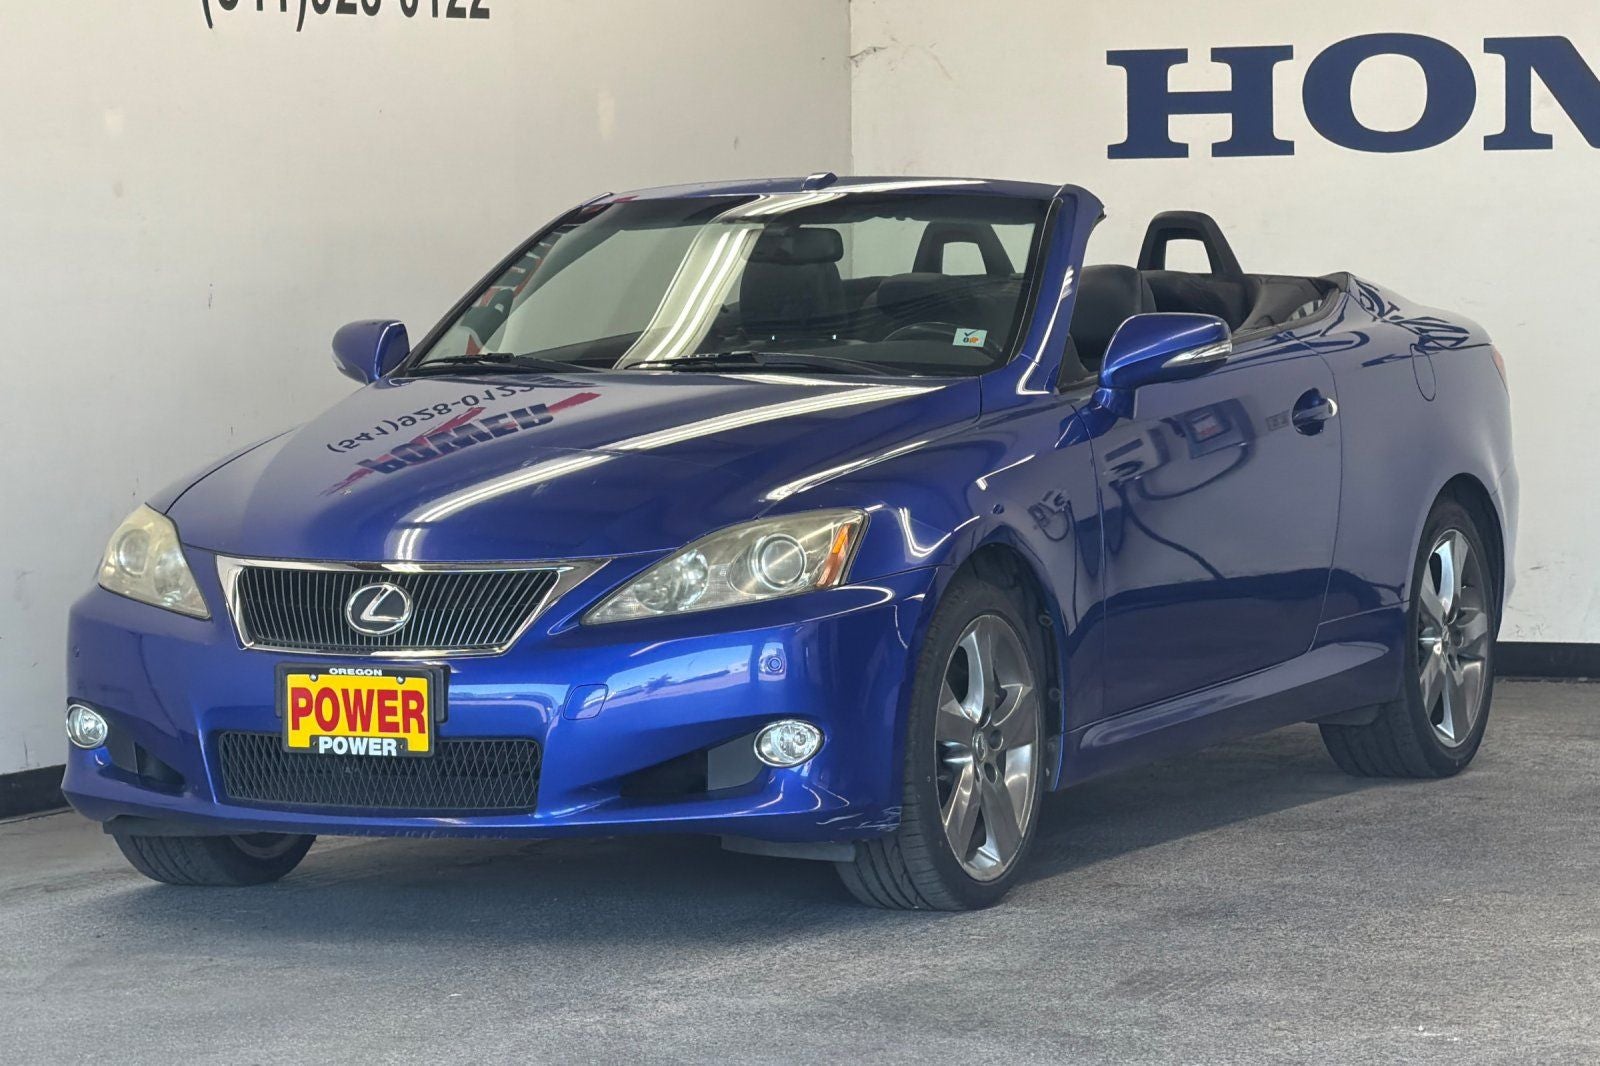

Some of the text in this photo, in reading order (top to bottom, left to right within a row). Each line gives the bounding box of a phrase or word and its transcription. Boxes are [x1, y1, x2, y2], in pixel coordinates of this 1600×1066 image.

[328, 667, 383, 676] OREGON
[290, 687, 426, 734] POWER
[318, 736, 398, 757] POWER
